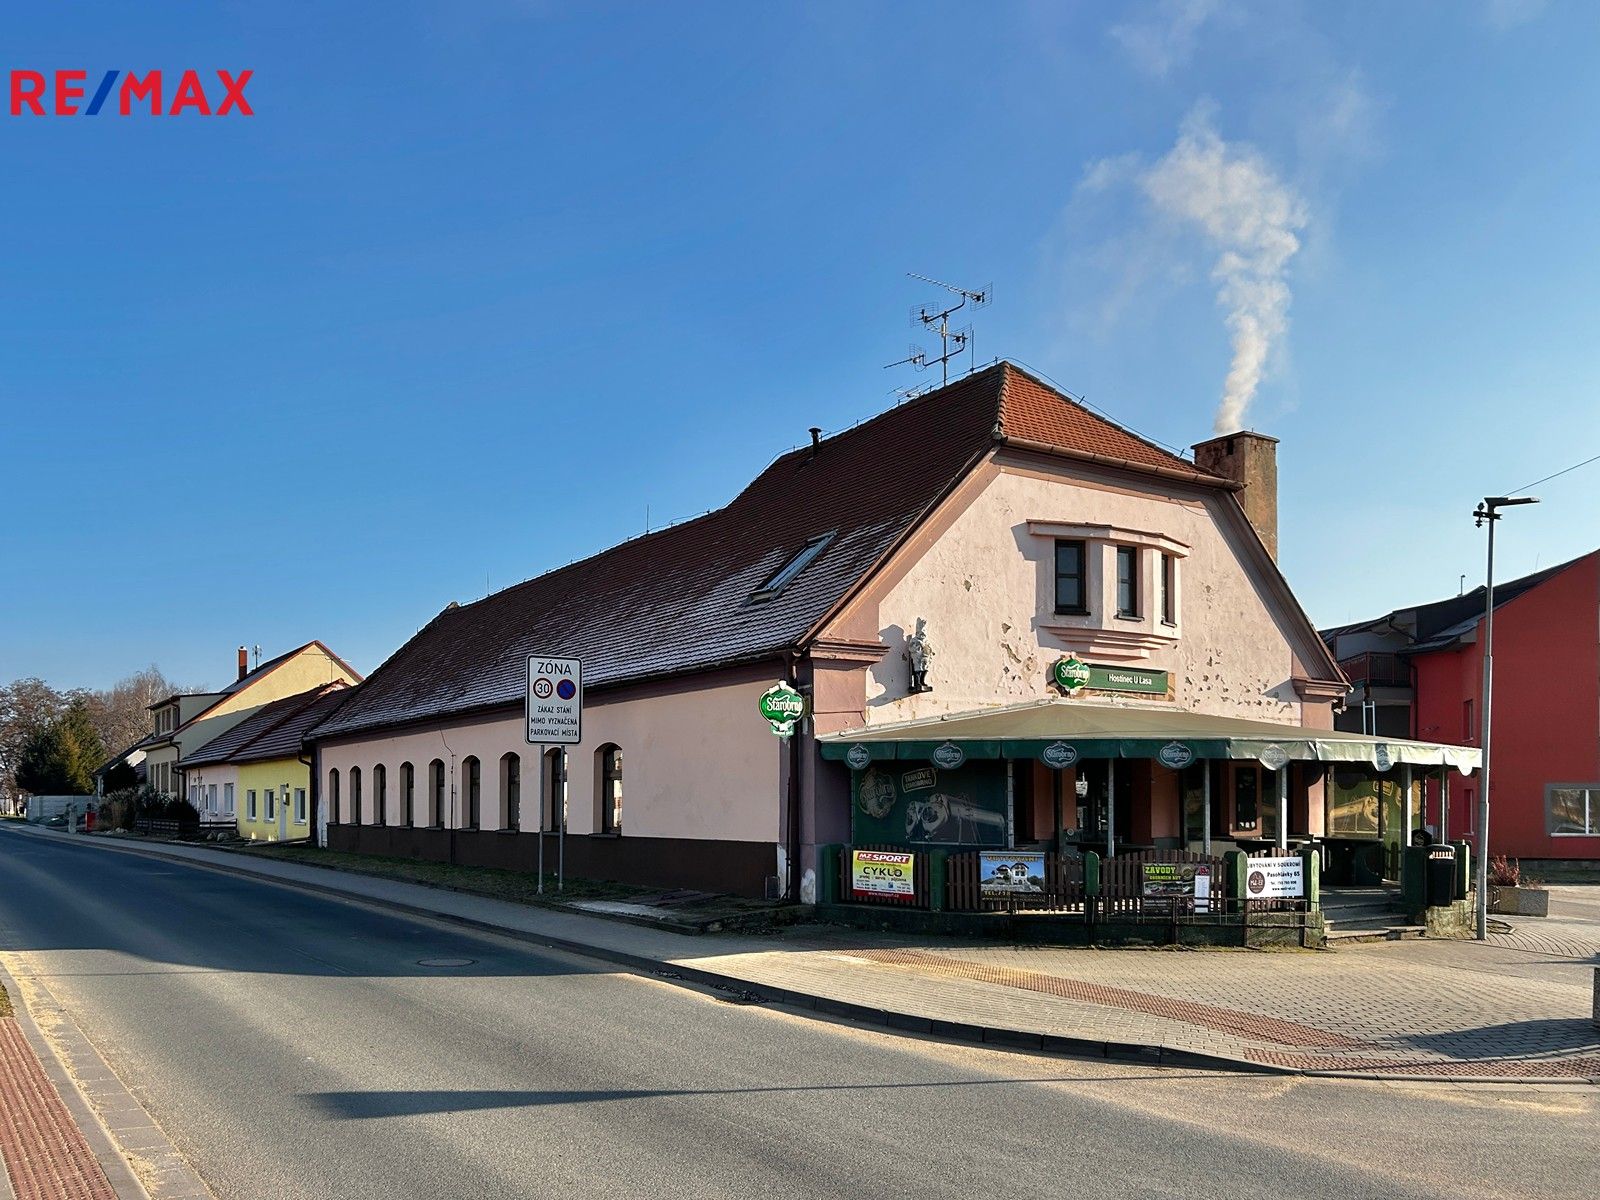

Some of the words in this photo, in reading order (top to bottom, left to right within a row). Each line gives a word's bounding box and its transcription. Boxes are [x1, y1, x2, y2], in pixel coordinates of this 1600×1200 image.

[537, 660, 573, 675] ZÓNA
[1108, 673, 1133, 684] Hostinec
[1133, 676, 1139, 684] U
[1139, 676, 1153, 685] Lasa
[537, 683, 550, 694] 30
[537, 705, 554, 713] ZÁKAZ
[531, 717, 546, 725] MIMO
[863, 866, 903, 877] CYKLO
